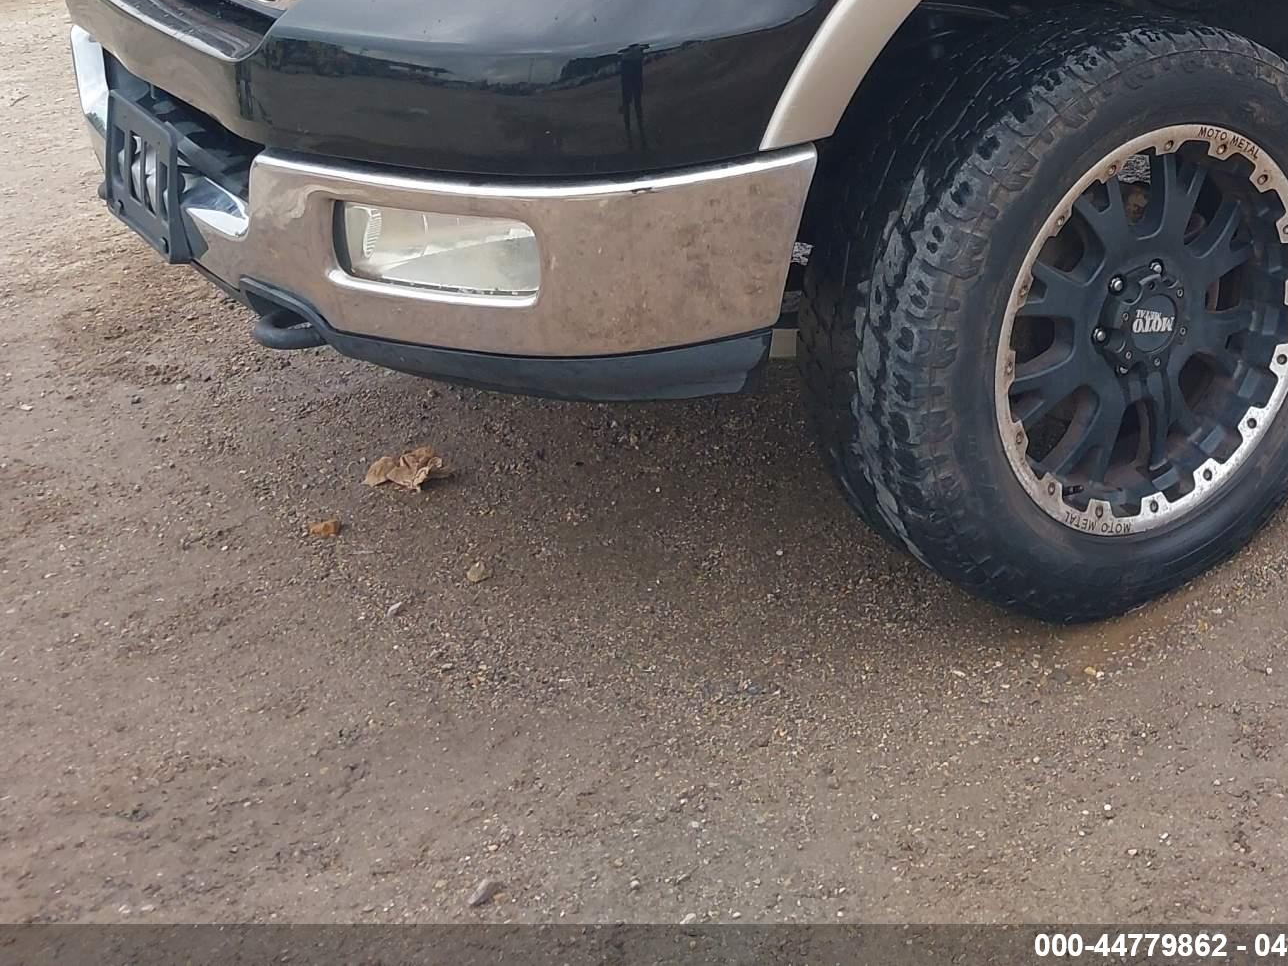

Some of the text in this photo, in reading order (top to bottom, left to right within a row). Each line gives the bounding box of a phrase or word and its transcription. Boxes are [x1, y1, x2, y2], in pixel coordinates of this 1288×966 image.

[1198, 126, 1260, 159] MOTO METAL
[1132, 317, 1175, 333] MOTO
[1064, 511, 1132, 534] MOTO METAL
